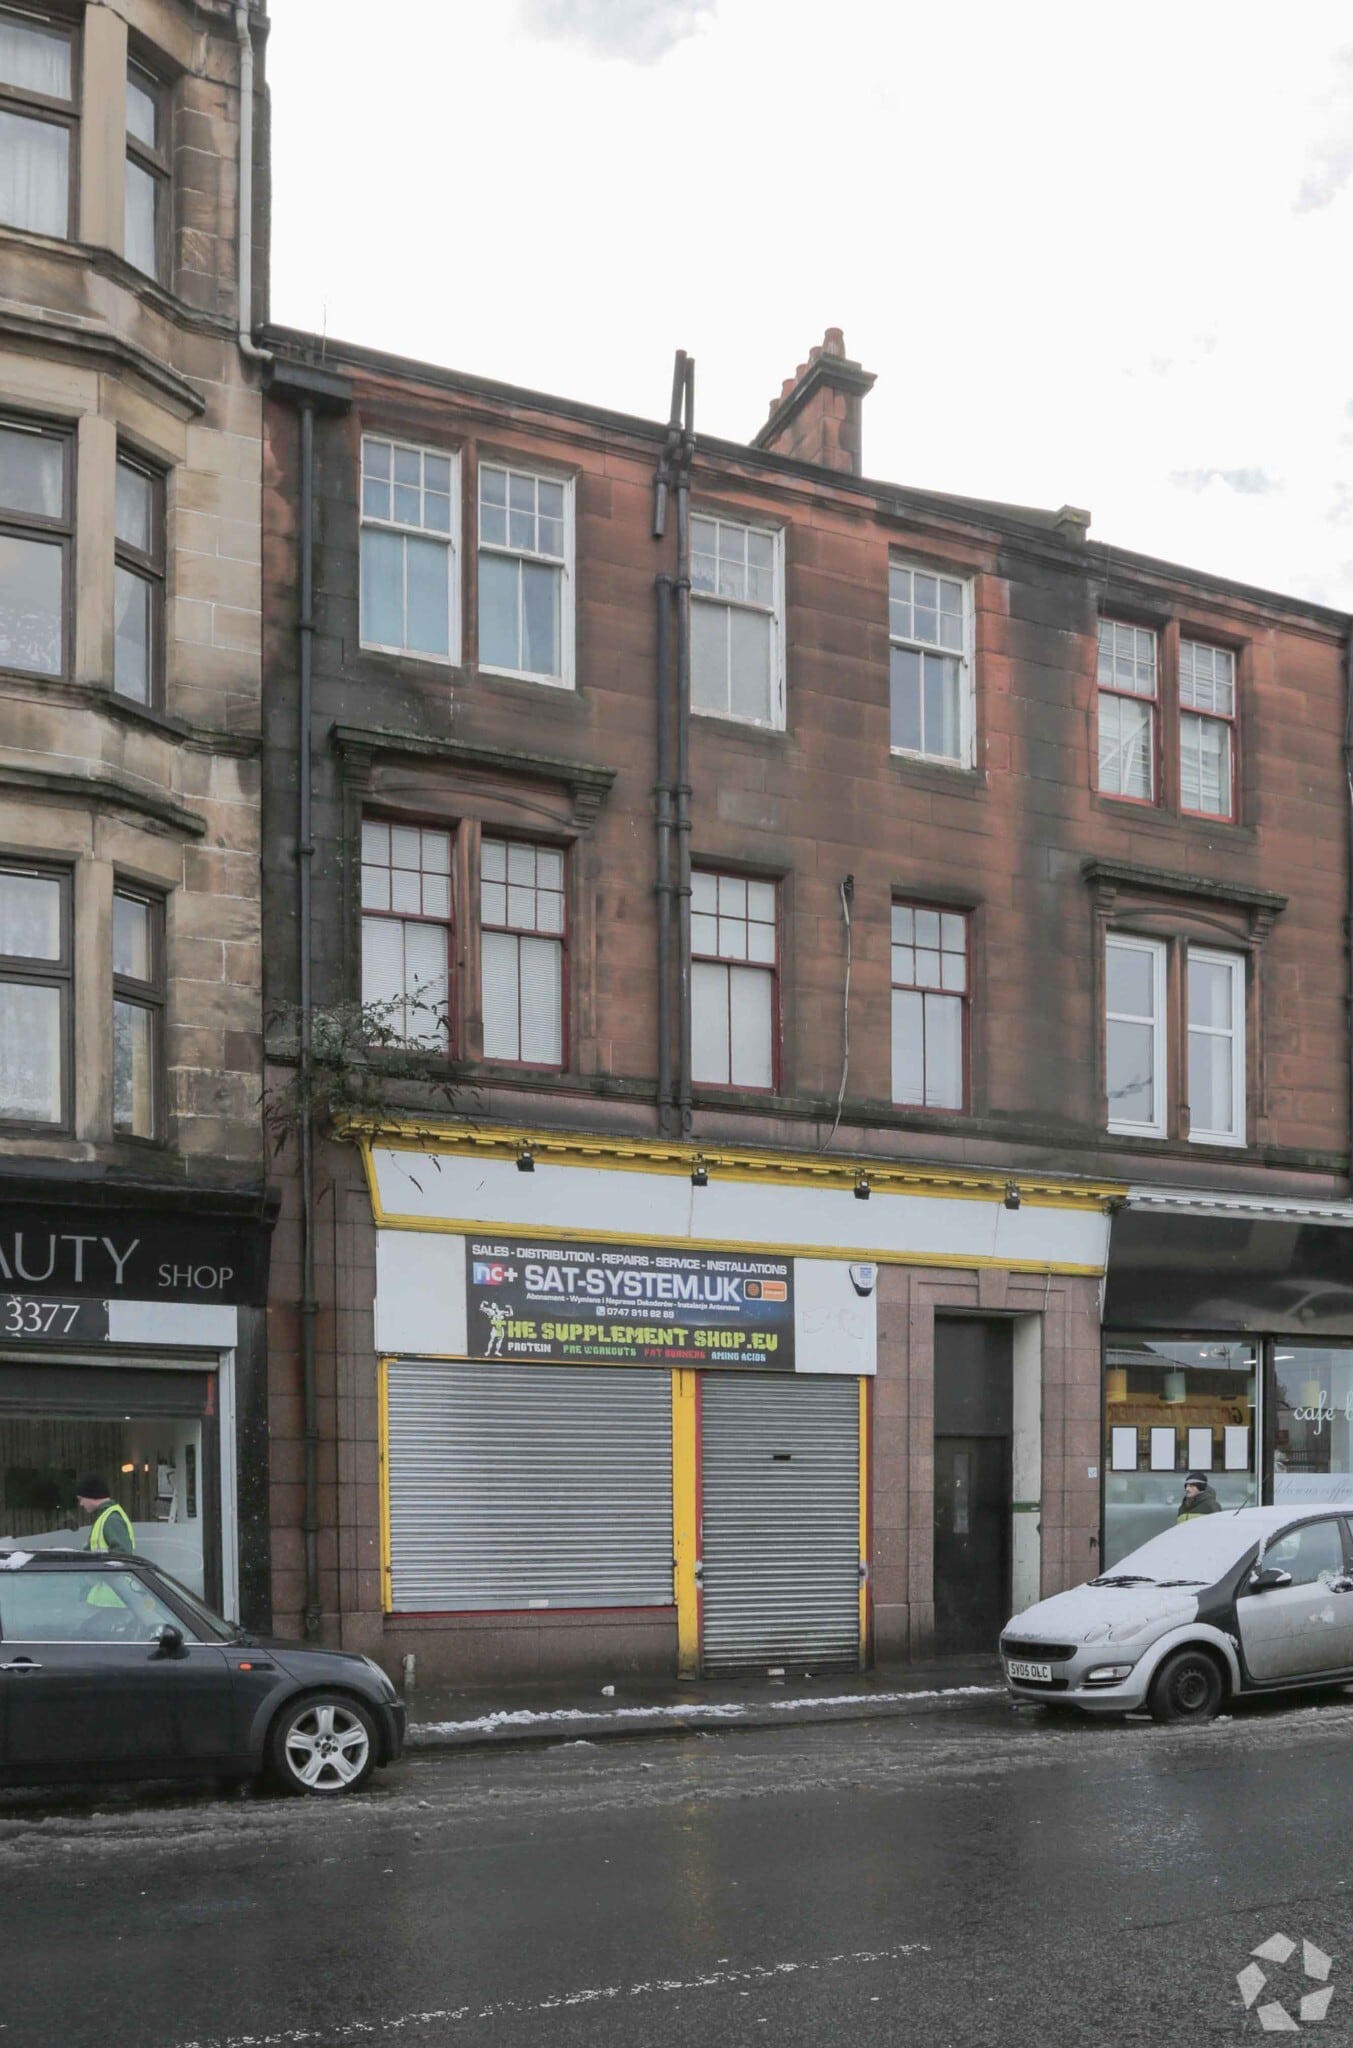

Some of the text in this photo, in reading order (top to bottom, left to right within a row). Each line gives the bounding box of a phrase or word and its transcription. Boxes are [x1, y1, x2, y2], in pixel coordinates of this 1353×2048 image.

[472, 1244, 509, 1257] SALES
[517, 1247, 595, 1263] DISTRIBUTION
[602, 1253, 649, 1266] REPAIRS
[656, 1257, 700, 1270] SERVICE
[707, 1260, 788, 1275] INSTALLATIONS
[158, 1264, 234, 1289] SHOP
[524, 1264, 742, 1302] SAT-SYSTEM.UK
[5, 1301, 80, 1333] 3377
[607, 1307, 629, 1316] 0747
[491, 1318, 778, 1351] THE SUPPLEMENT SHOP.EU
[507, 1342, 552, 1353] PROTEIN
[563, 1344, 582, 1354] PRE
[584, 1346, 637, 1356] WORKOUTS
[644, 1348, 663, 1357] FAT
[711, 1351, 740, 1361] AMINO
[741, 1352, 766, 1362] ACIDS
[1293, 1390, 1336, 1435] cafe
[1031, 1665, 1048, 1679] OLC
